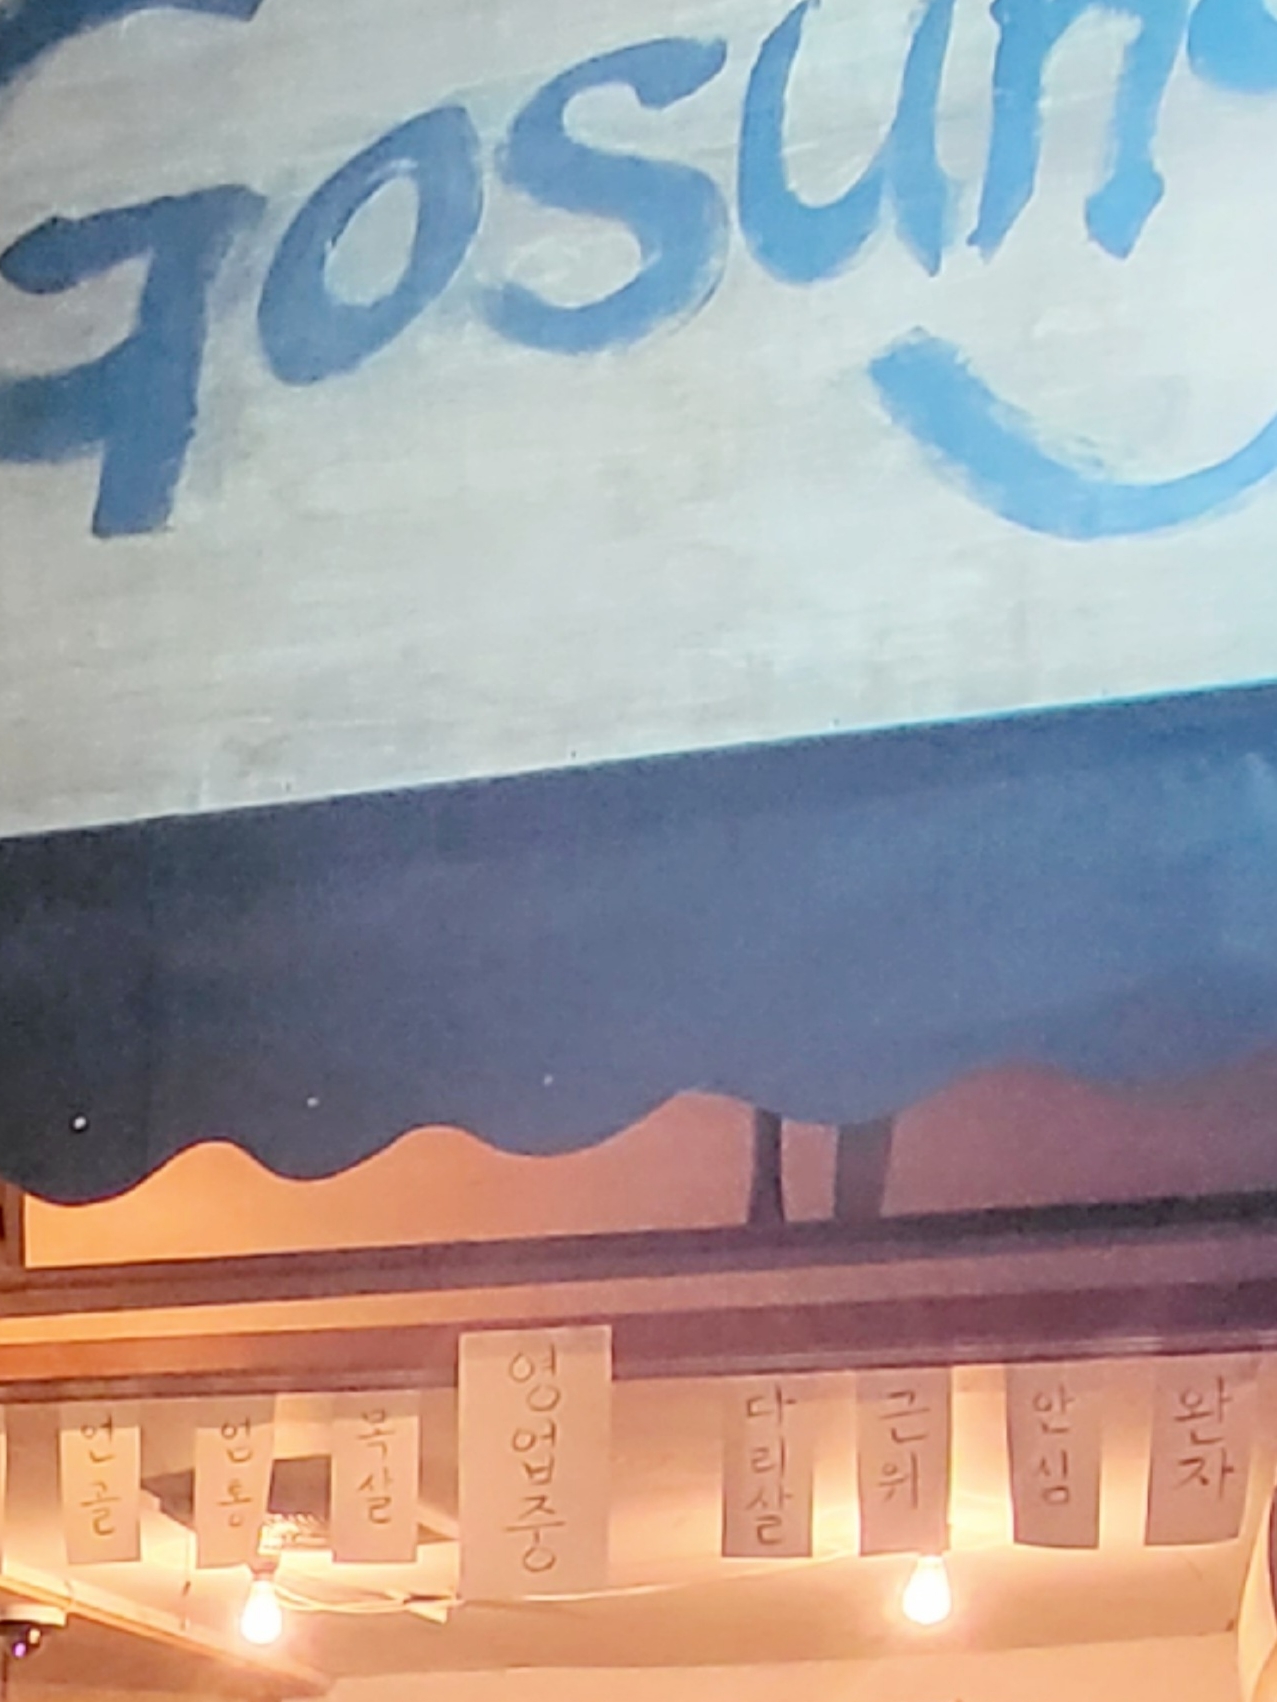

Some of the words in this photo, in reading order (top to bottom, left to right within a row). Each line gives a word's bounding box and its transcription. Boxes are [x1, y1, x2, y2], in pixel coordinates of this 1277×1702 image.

[503, 1343, 566, 1575] 영업중
[744, 1384, 797, 1547] 다리살
[1032, 1384, 1075, 1506] 안심
[1172, 1376, 1235, 1501] 완자
